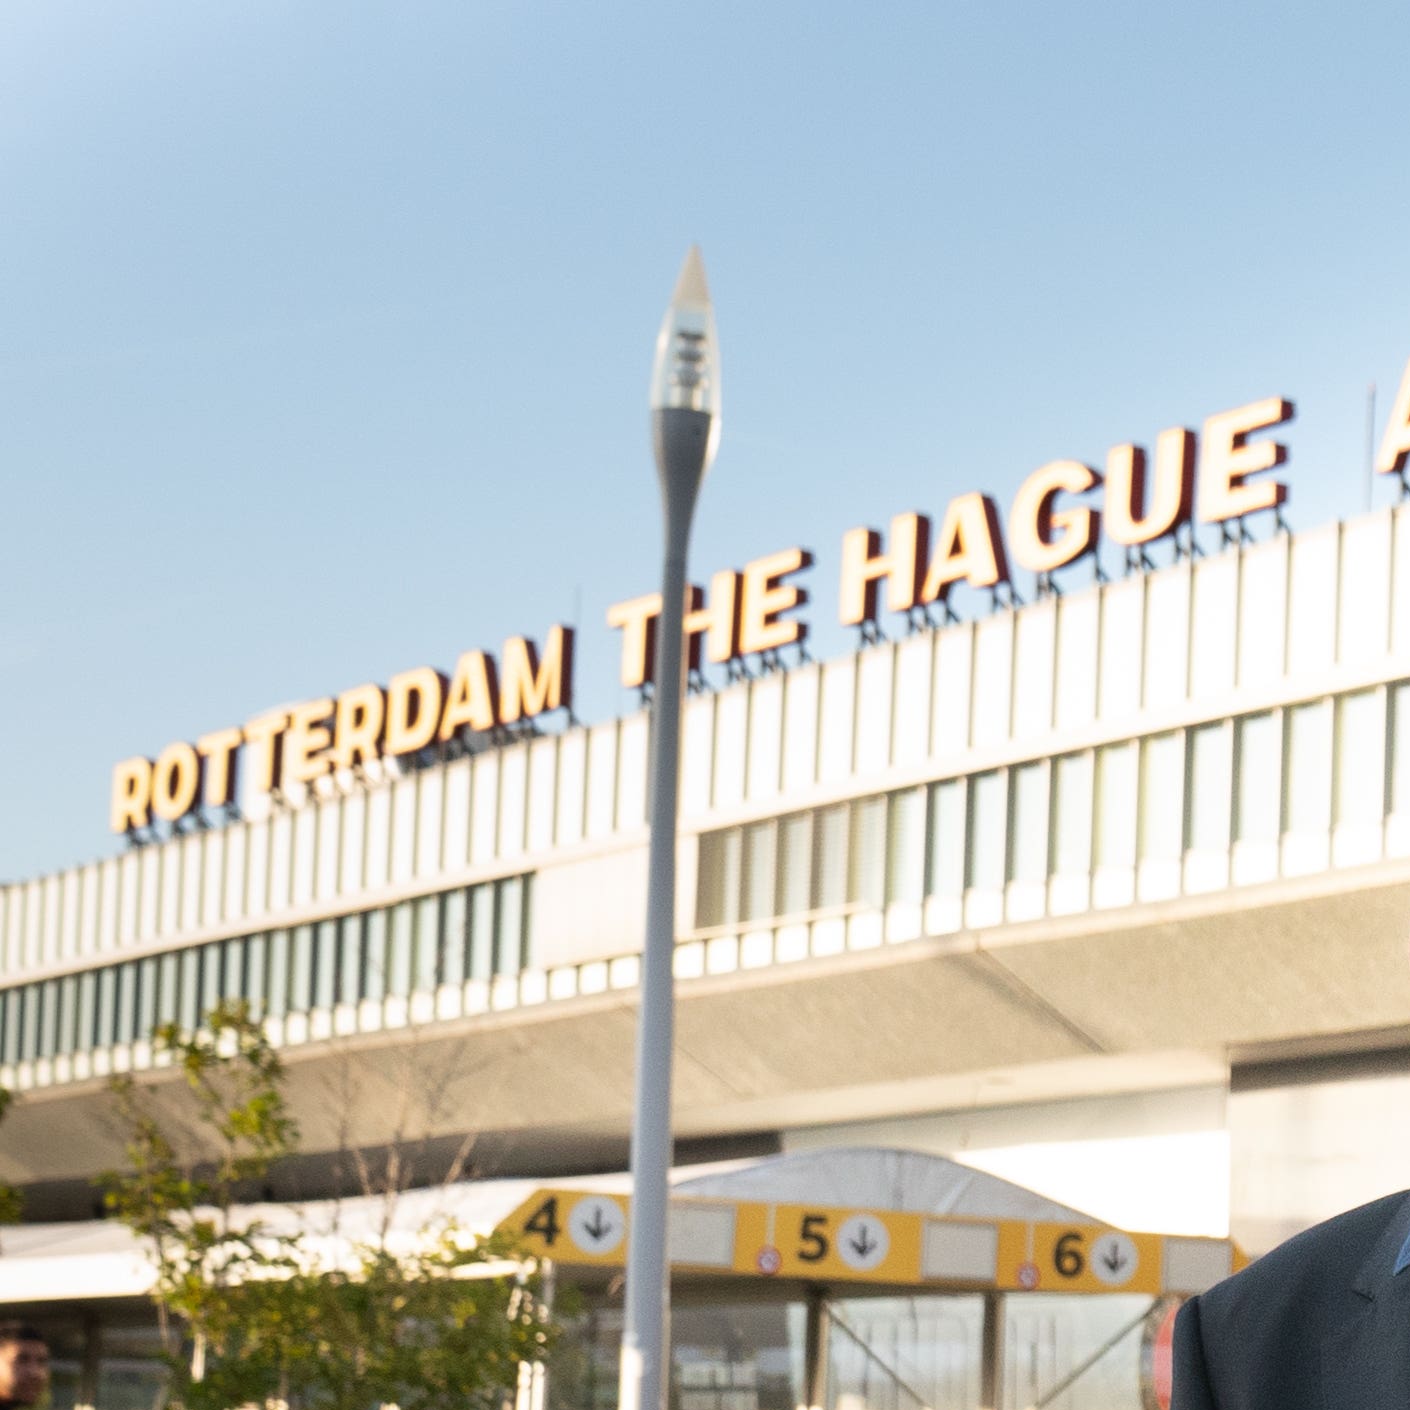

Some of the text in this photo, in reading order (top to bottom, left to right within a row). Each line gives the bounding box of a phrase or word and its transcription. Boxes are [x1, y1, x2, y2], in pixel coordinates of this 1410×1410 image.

[111, 624, 574, 833] ROTTERDAM
[607, 547, 814, 687] THE
[839, 396, 1296, 625] HAGUE
[522, 1196, 561, 1247] 4
[797, 1213, 830, 1263] 5
[1052, 1231, 1086, 1278] 6
